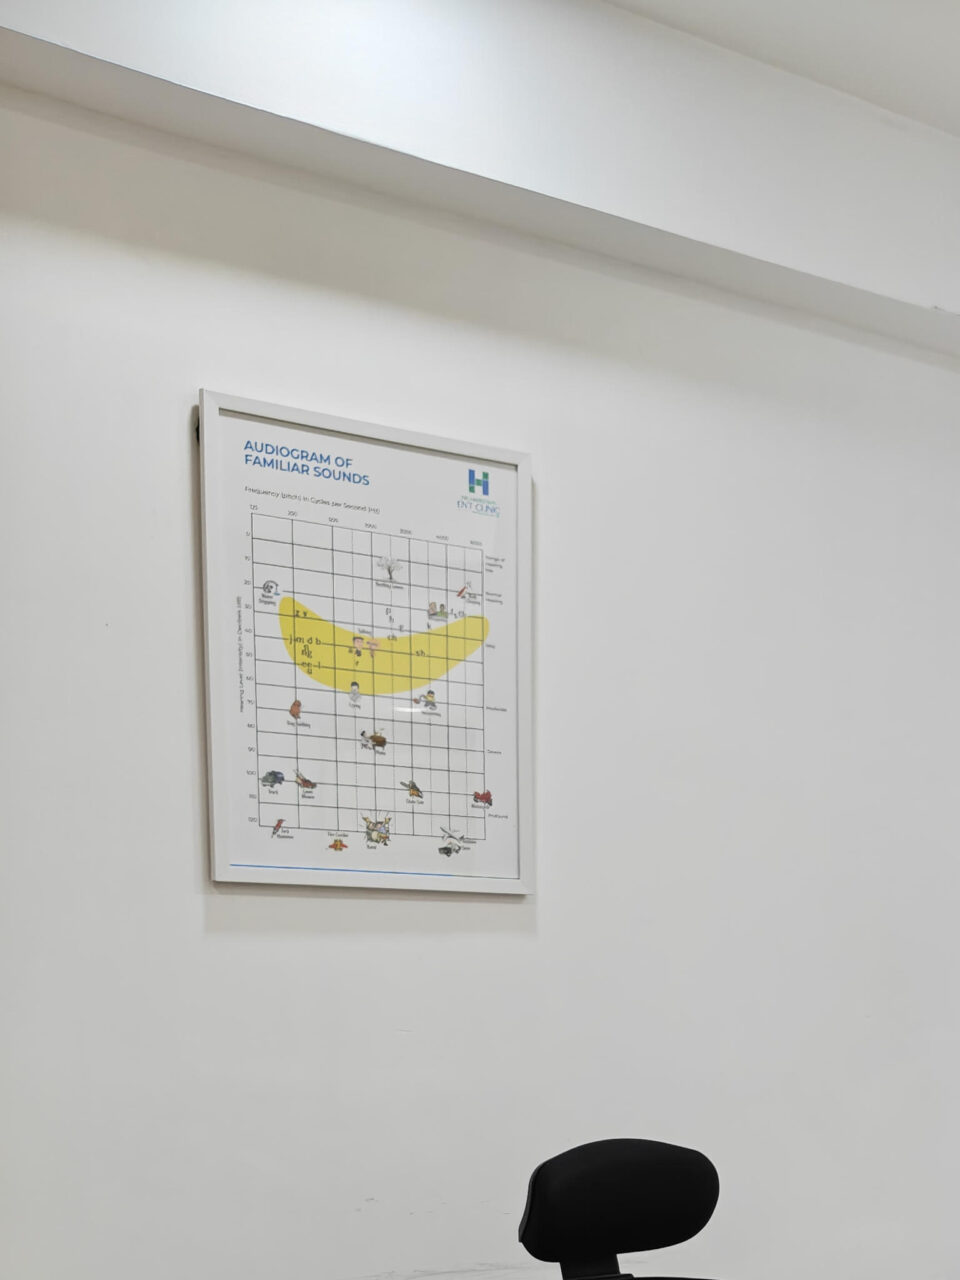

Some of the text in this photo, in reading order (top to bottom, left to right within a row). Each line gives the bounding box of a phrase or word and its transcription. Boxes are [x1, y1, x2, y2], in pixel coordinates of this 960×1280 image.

[243, 440, 353, 469] AUDIOGRAM OF
[244, 454, 370, 486] FAMILIAR SOUNDS
